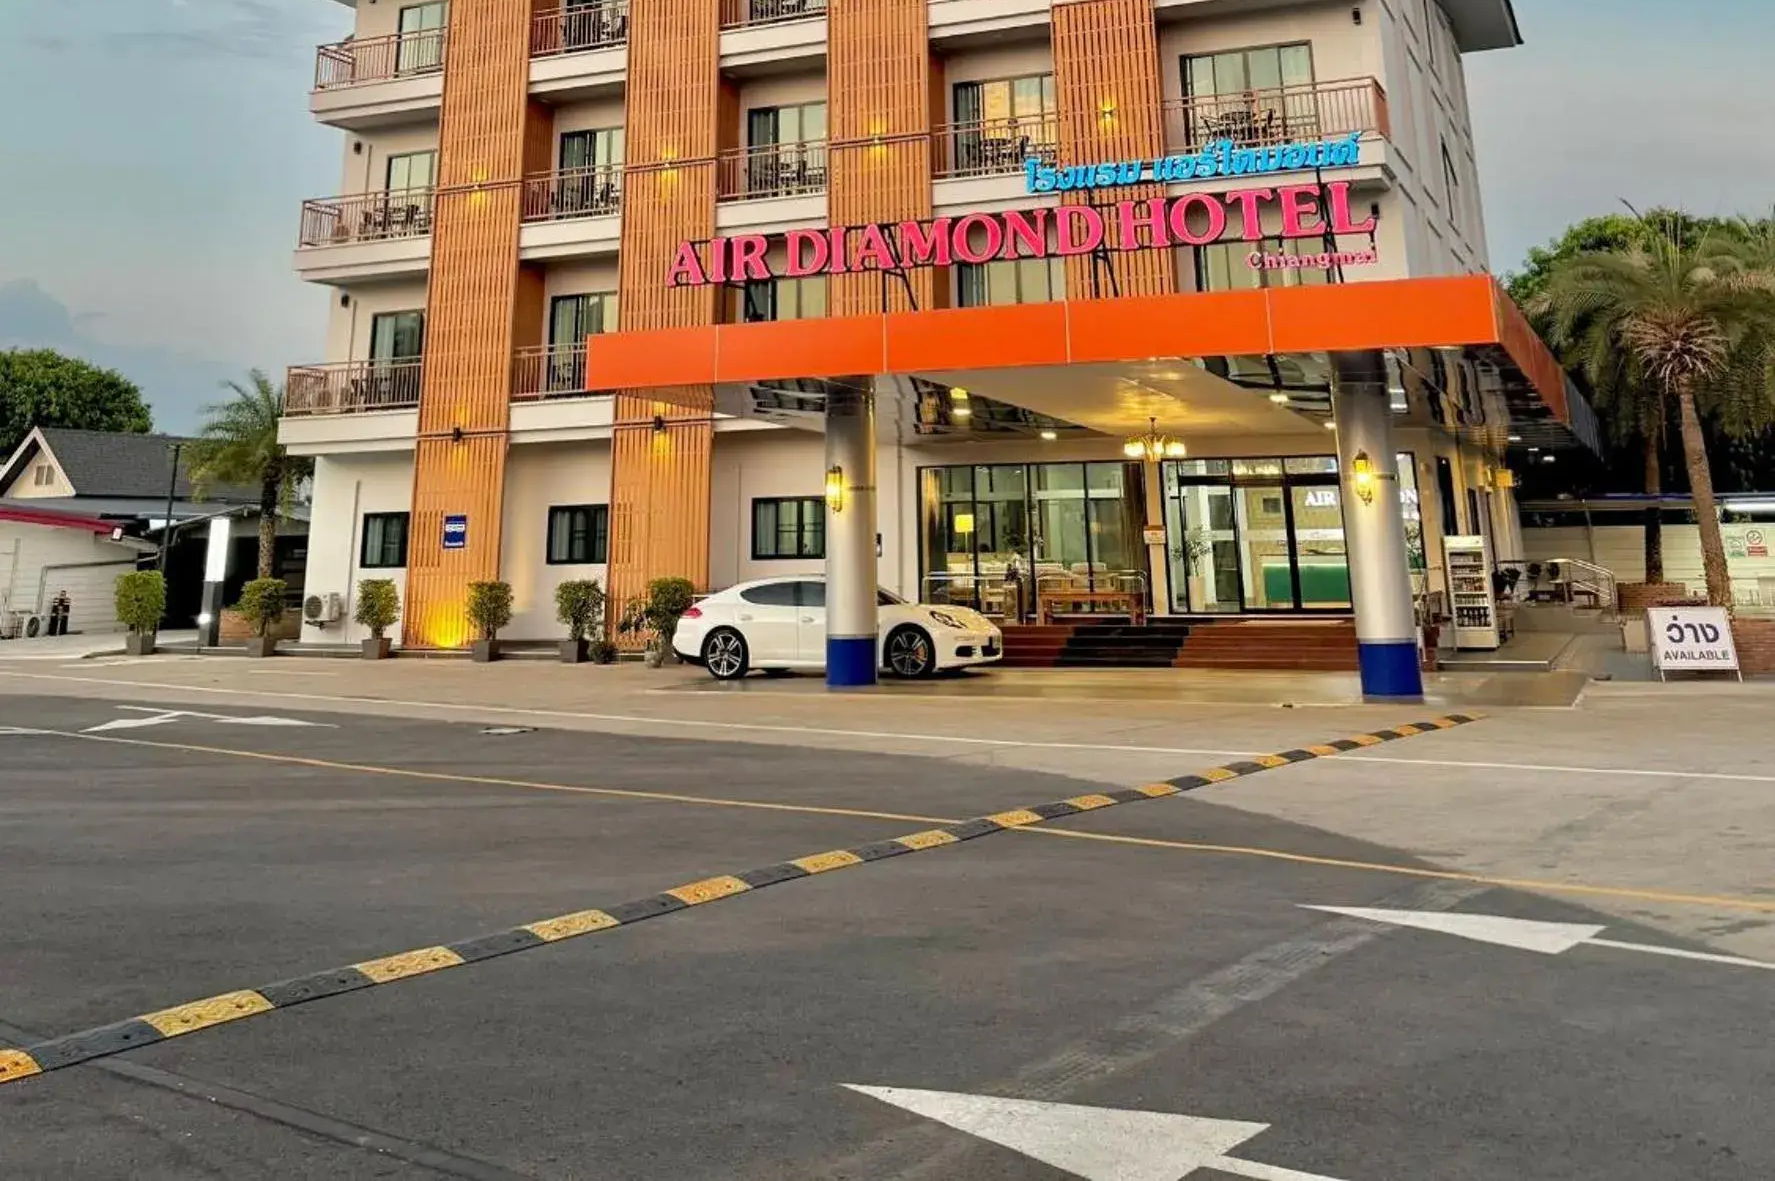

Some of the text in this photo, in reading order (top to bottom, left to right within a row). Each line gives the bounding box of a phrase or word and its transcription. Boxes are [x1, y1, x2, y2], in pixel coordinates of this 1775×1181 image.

[1024, 156, 1142, 193] โรงแรม
[665, 181, 1378, 287] AIR DIAMOND HOTEL
[1304, 490, 1337, 507] AIR
[1666, 615, 1720, 644] ว่าง
[1664, 649, 1730, 662] AVAILABLE
